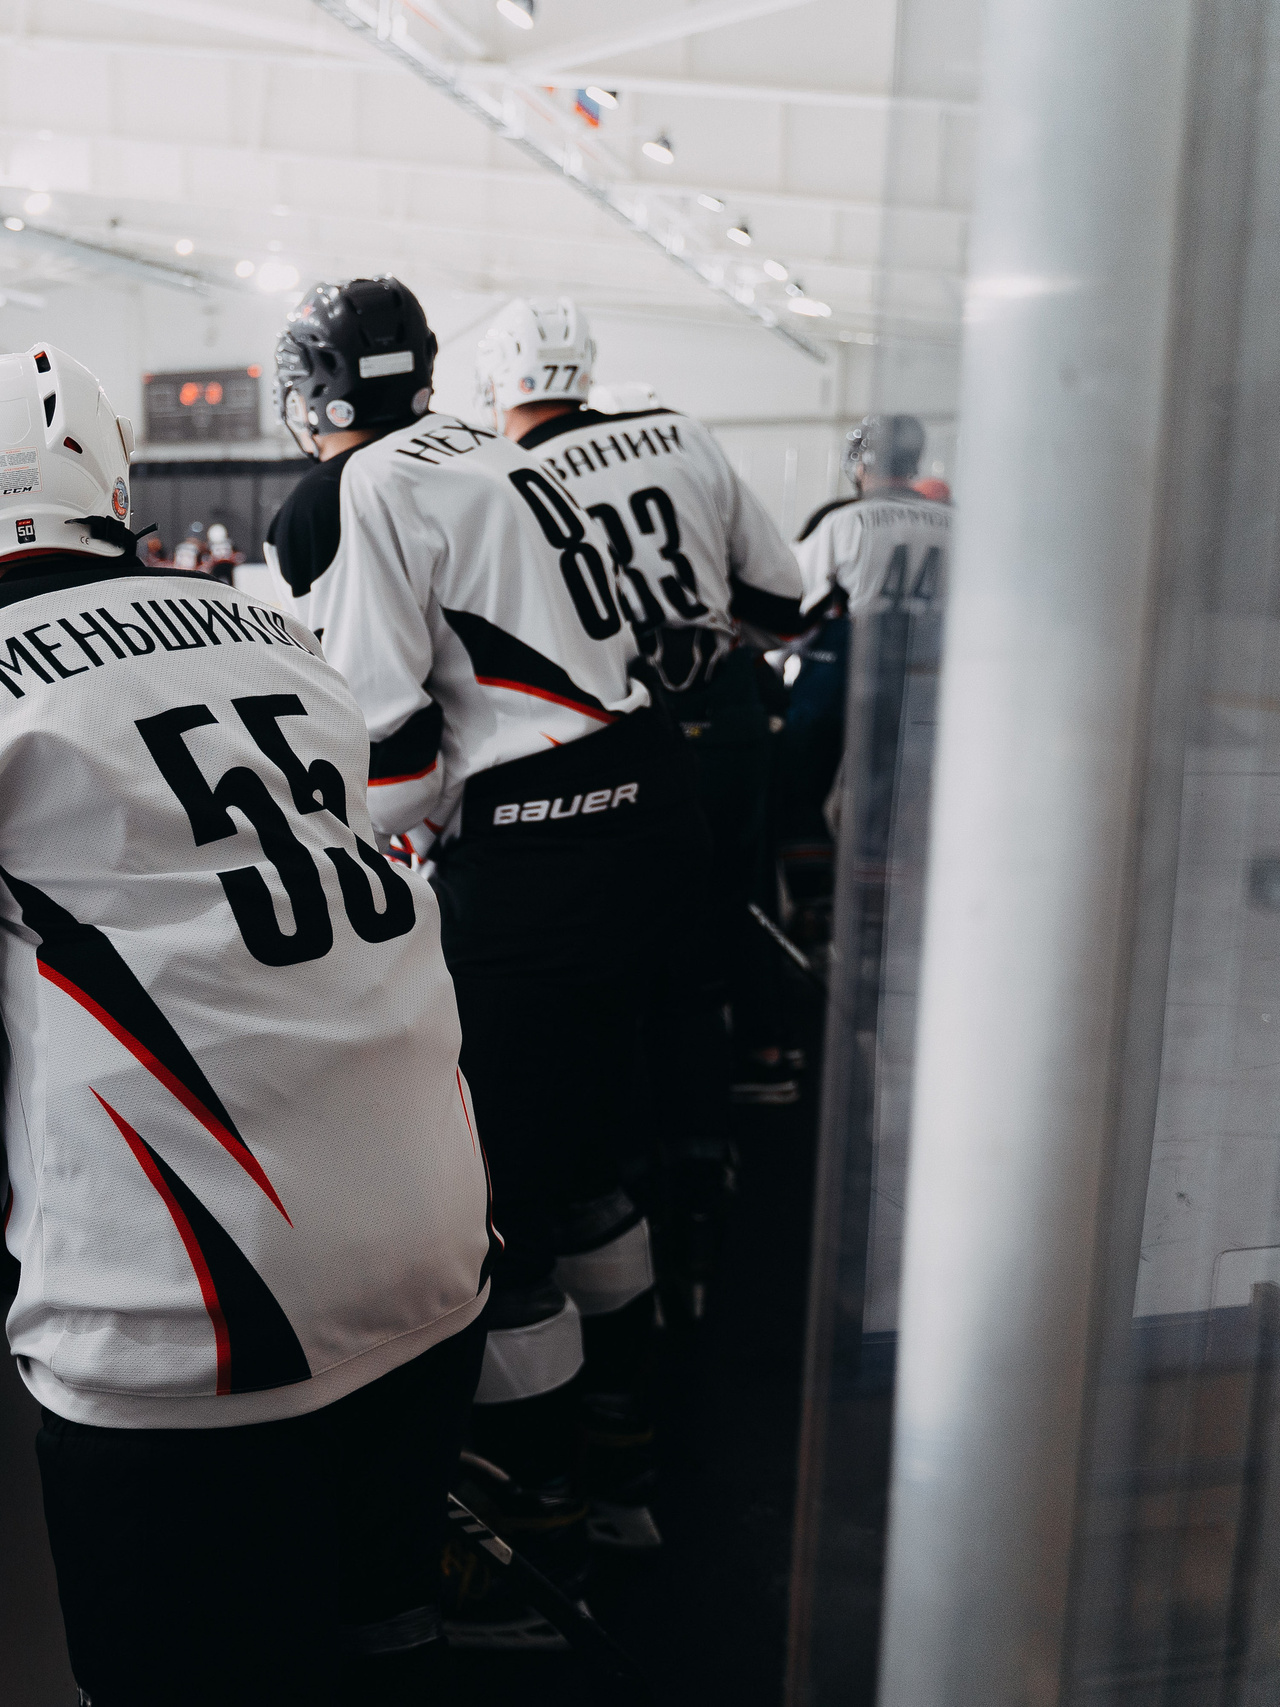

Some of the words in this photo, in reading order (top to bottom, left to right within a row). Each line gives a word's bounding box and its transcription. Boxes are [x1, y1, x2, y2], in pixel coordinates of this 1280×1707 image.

[543, 364, 579, 391] 77
[3, 486, 32, 495] CCM
[17, 525, 34, 537] 50
[493, 782, 639, 825] BAUER
[134, 694, 416, 967] 55
